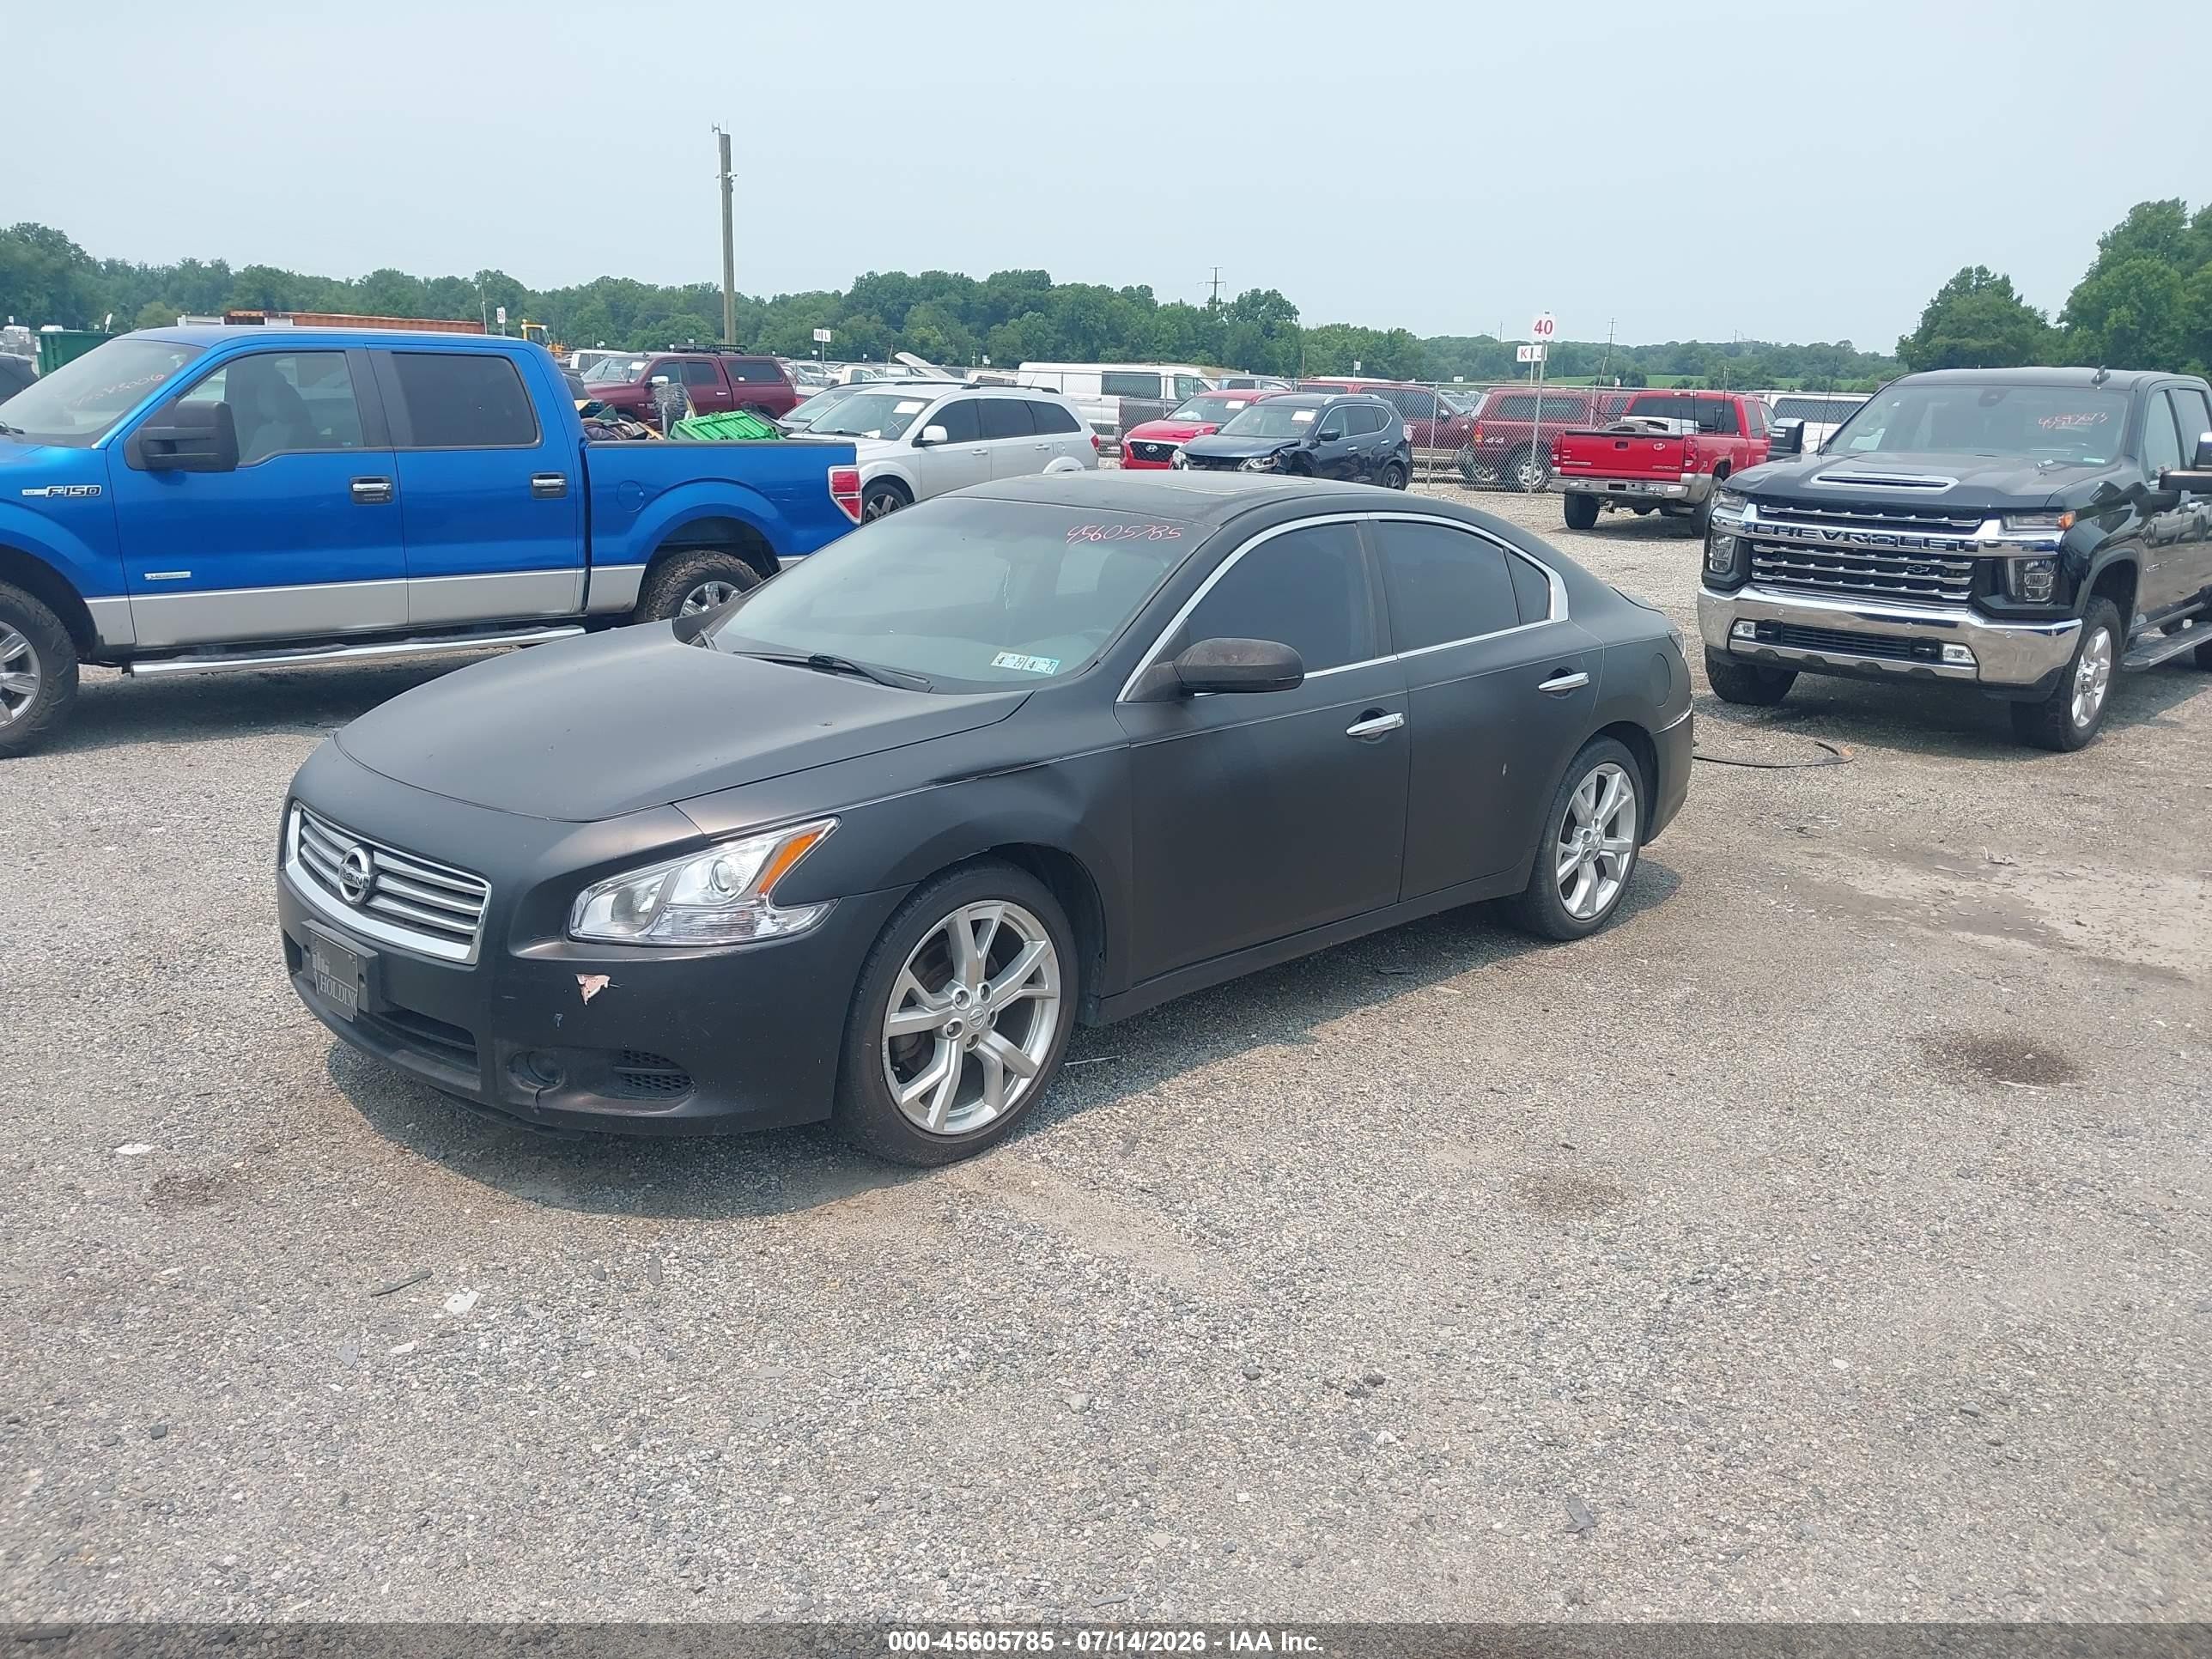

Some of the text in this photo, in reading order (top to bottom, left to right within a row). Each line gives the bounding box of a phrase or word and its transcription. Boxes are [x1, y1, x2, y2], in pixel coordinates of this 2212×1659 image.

[1534, 319, 1553, 335] 40
[46, 485, 101, 497] F-150
[1066, 525, 1184, 544] 45605785
[1752, 523, 1978, 551] CHEVROLET
